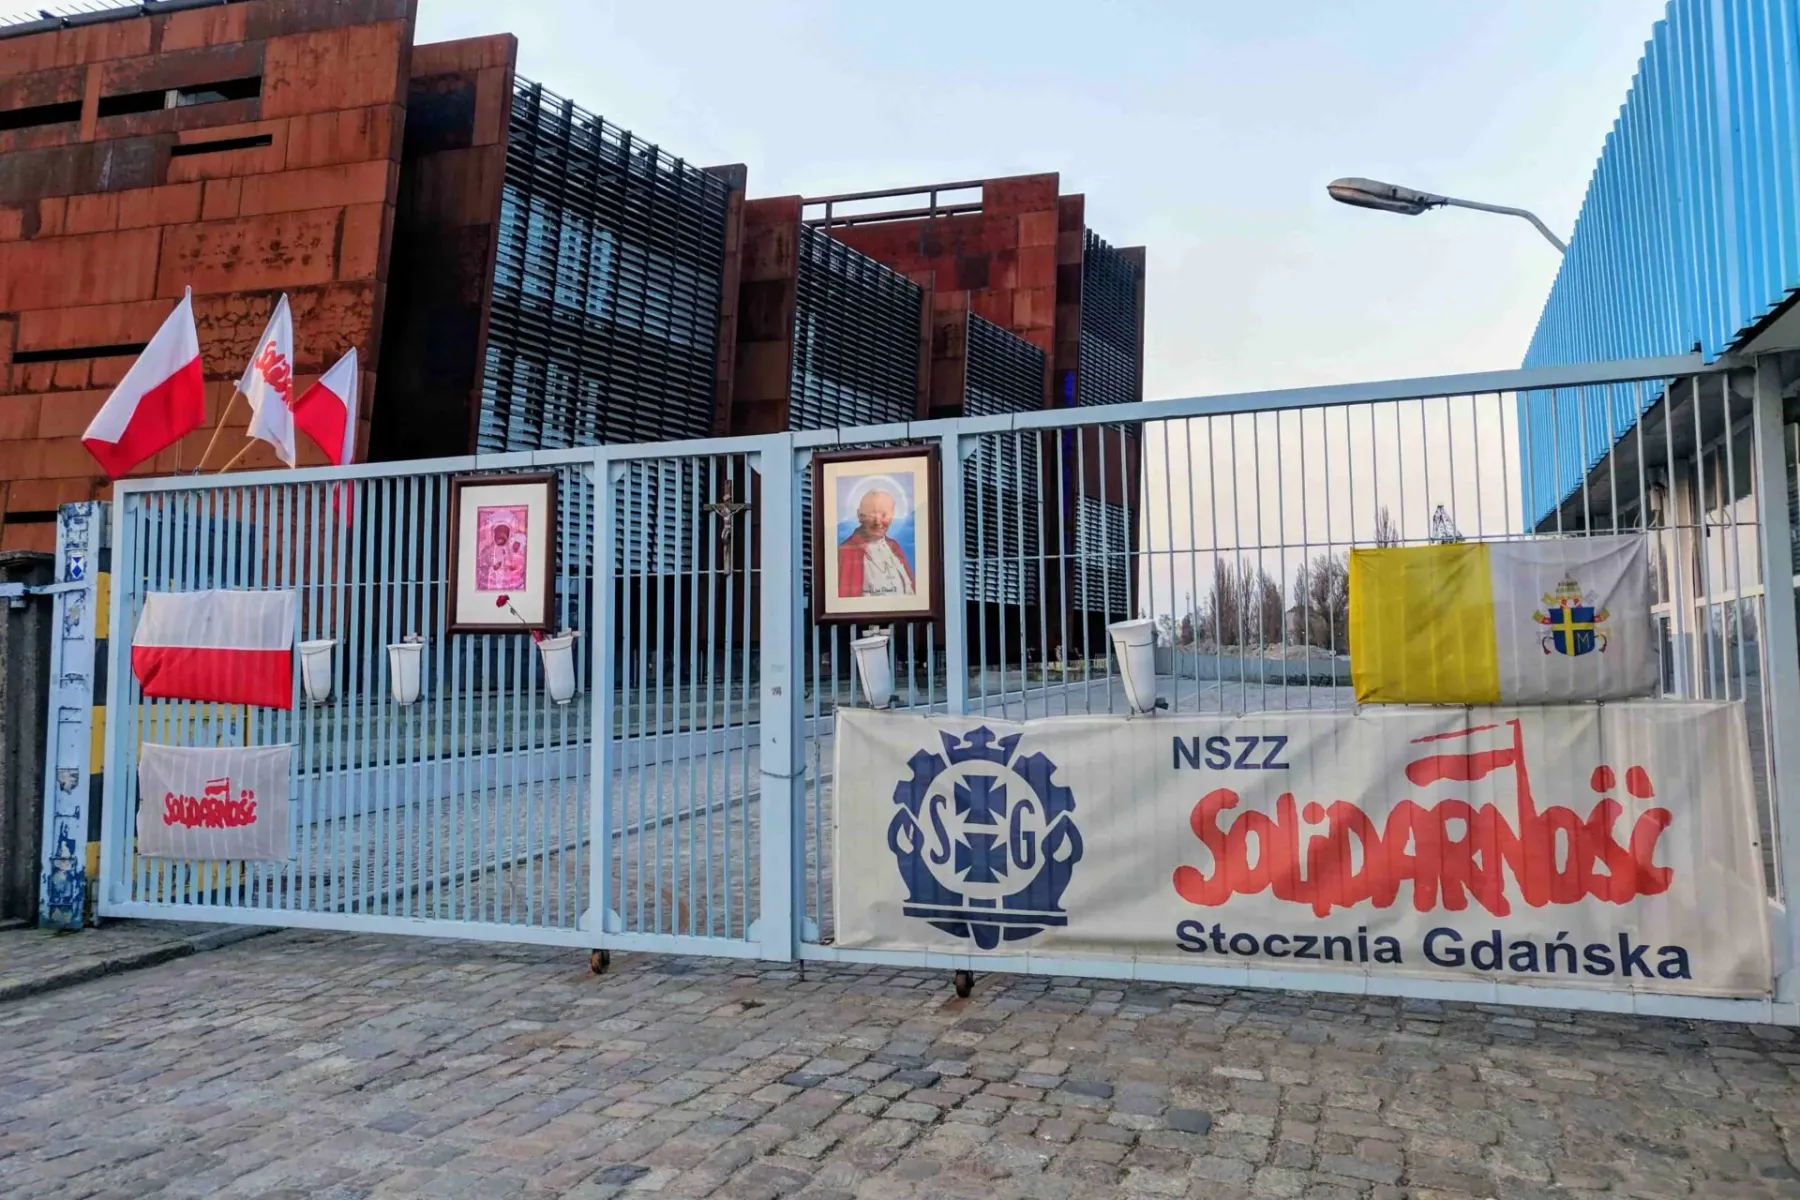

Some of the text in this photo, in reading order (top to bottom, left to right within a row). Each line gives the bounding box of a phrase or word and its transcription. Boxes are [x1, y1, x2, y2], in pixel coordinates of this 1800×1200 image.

[1172, 735, 1290, 771] NSZZ
[1175, 919, 1692, 980] Stocznia Gdańska
